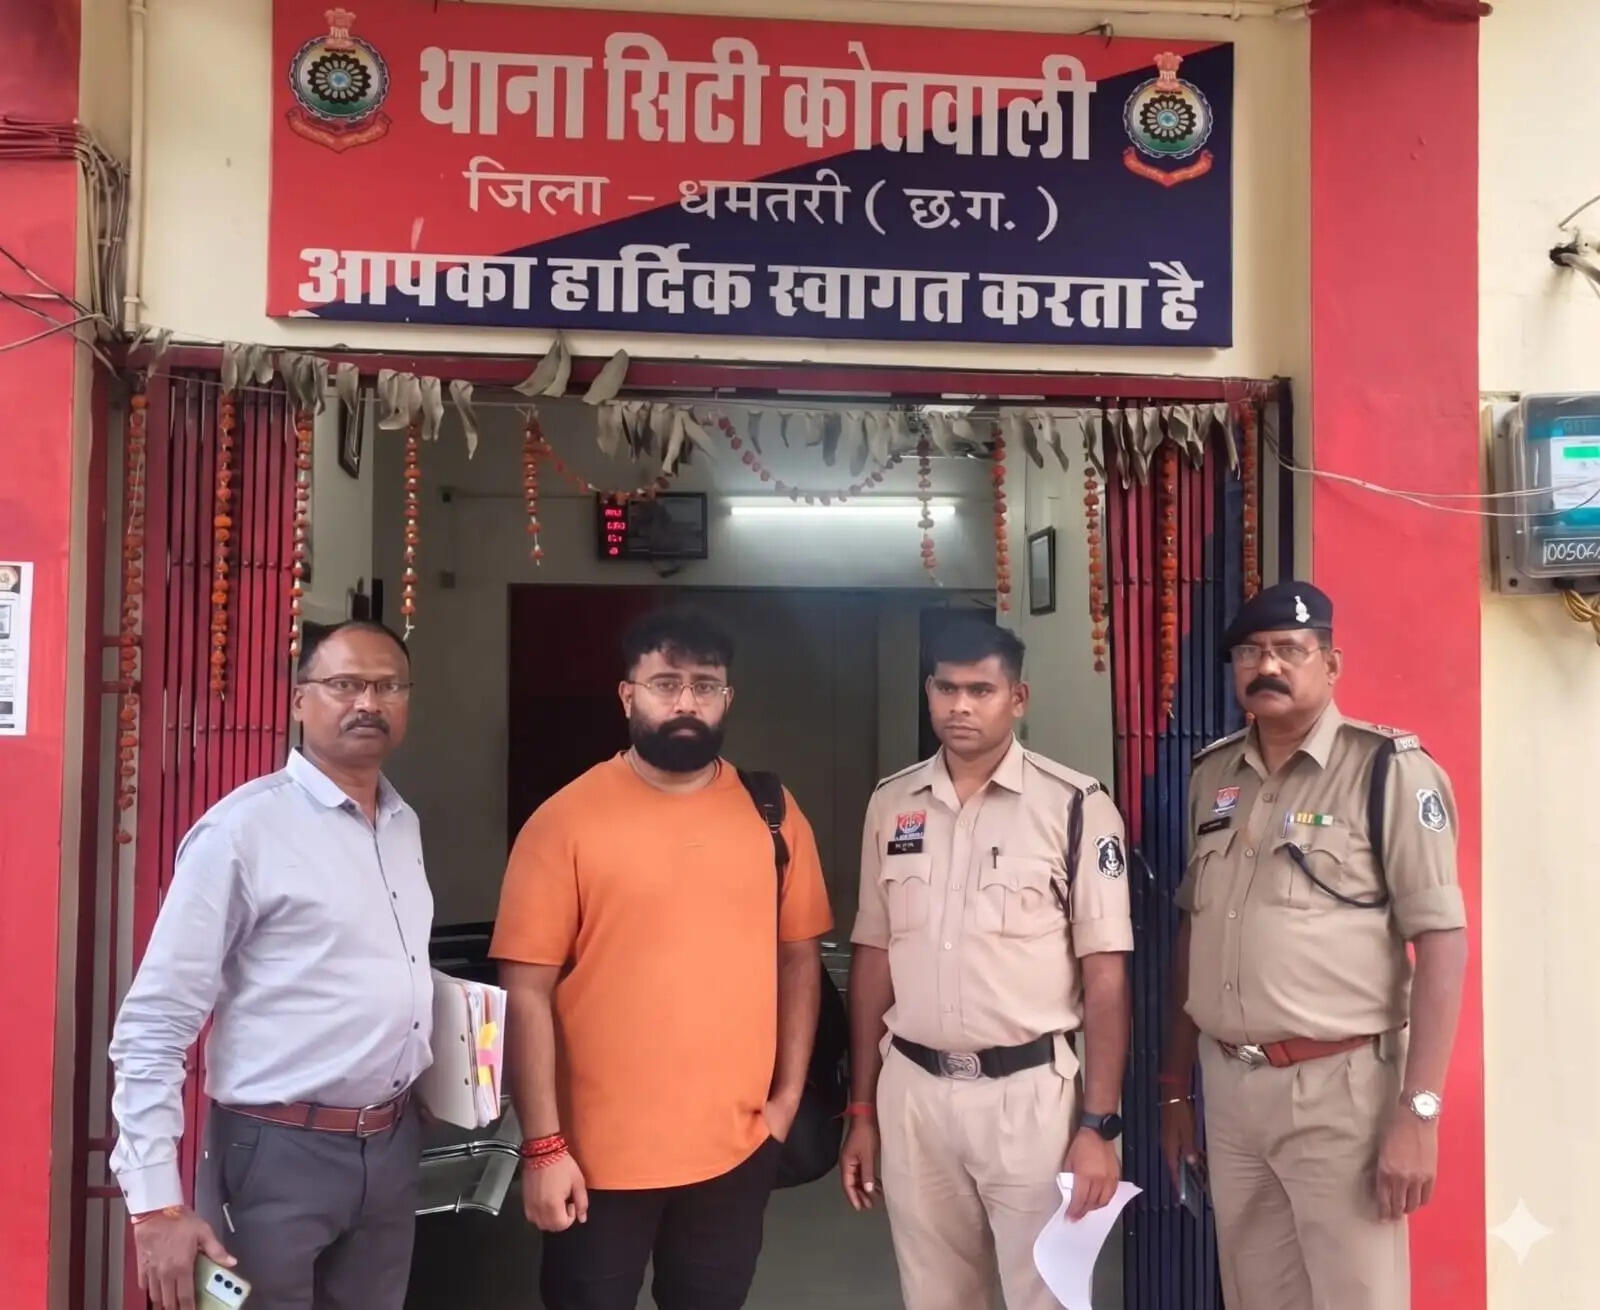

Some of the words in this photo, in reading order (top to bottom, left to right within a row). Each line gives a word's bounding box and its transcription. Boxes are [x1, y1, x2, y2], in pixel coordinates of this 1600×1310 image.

[420, 46, 593, 139] थाना
[604, 32, 770, 146] सिटी
[780, 41, 1097, 160] कोतवाली
[462, 156, 610, 216] जिला
[678, 168, 851, 225] धमतरी
[298, 247, 538, 310] आपका
[547, 243, 756, 315] हार्दिक
[767, 265, 970, 324] स्वागत
[979, 273, 1149, 329] करता
[1149, 261, 1204, 331] है
